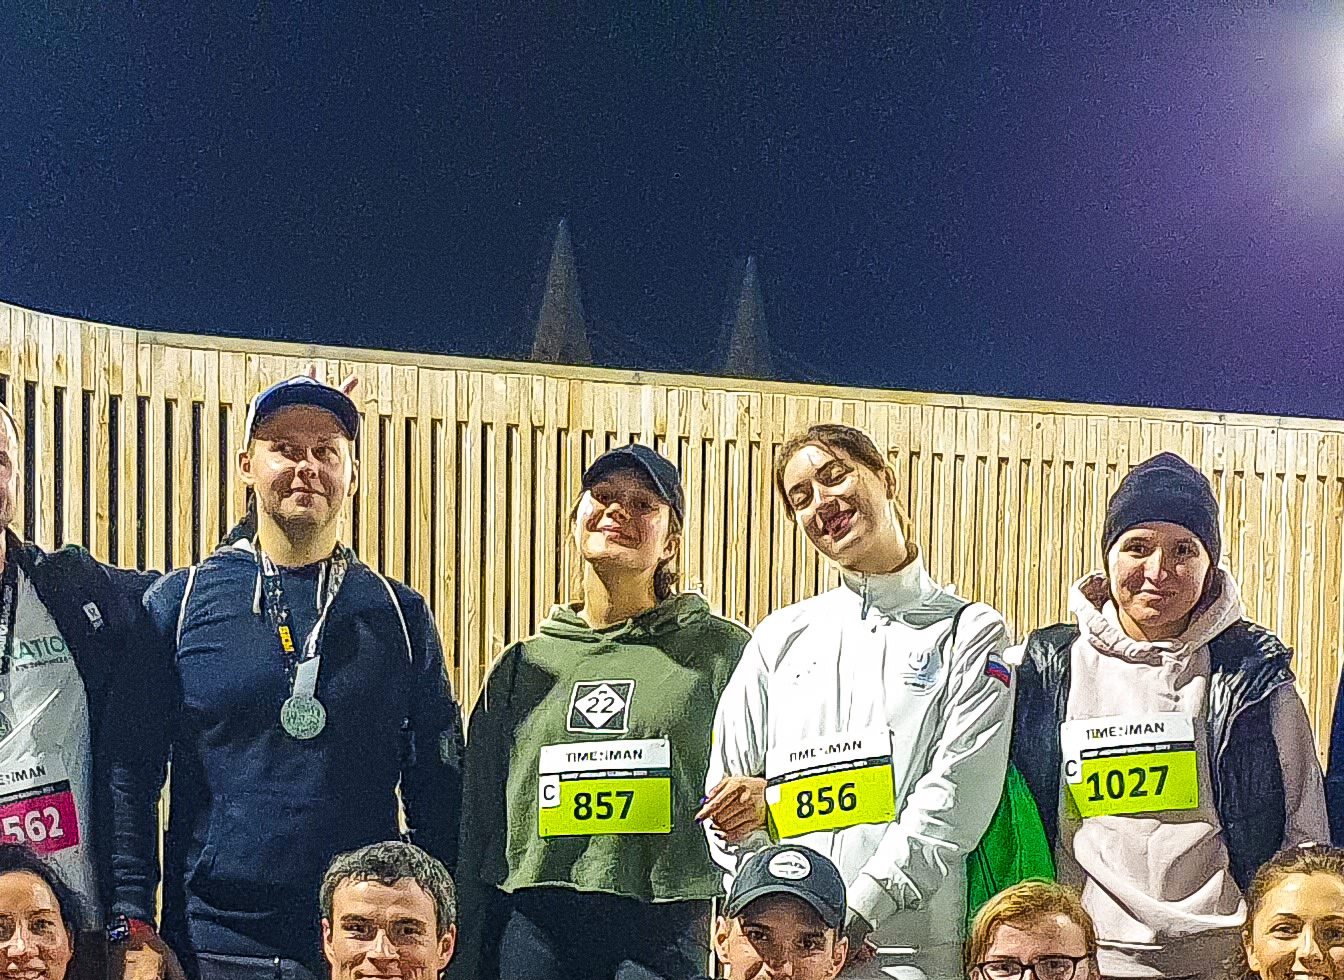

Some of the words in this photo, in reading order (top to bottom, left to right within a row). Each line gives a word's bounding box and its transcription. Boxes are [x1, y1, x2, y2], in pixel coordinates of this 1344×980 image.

[585, 696, 615, 714] 22
[1064, 759, 1078, 777] C
[543, 784, 556, 801] C
[1086, 764, 1169, 802] 1027
[573, 790, 635, 820] 857
[796, 782, 857, 819] 856
